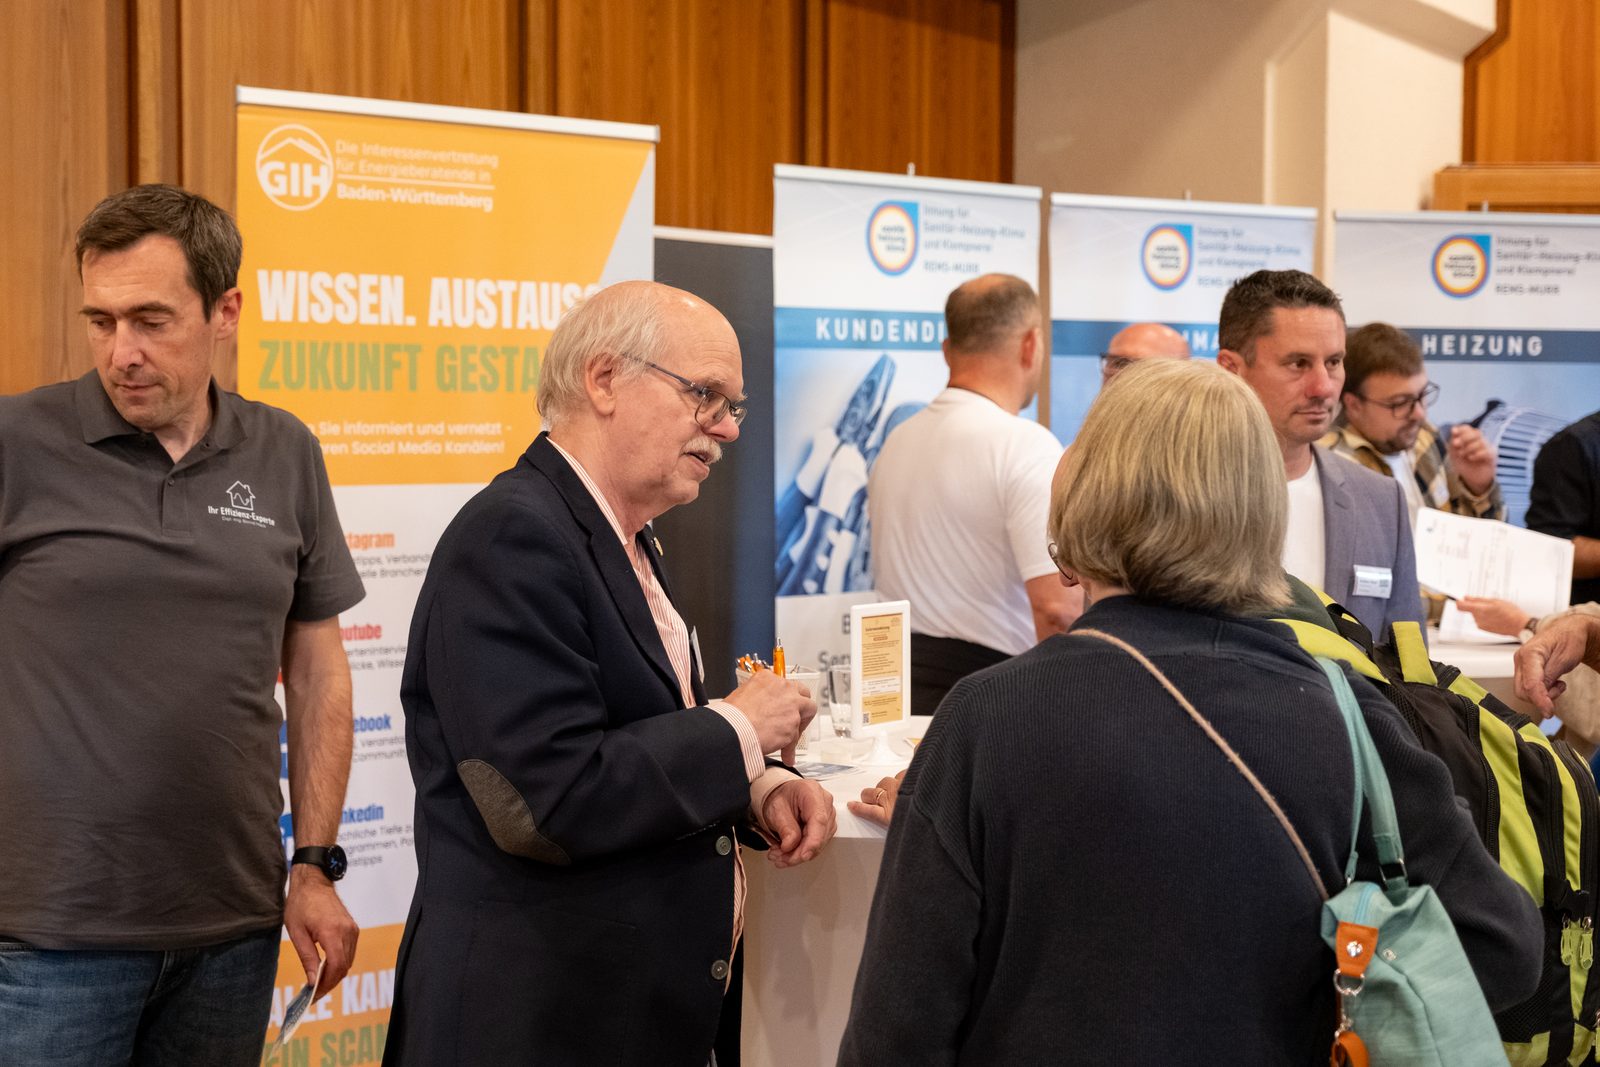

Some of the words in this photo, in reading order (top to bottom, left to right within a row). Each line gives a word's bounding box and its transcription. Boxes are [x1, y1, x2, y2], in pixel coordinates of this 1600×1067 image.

[335, 139, 359, 154] Die
[362, 143, 499, 170] Interessenvertretung
[260, 160, 332, 198] GIH
[335, 157, 355, 172] für
[359, 160, 477, 182] Energieberatende
[336, 183, 494, 213] Baden-Württemberg
[257, 269, 416, 326] WISSEN.
[428, 277, 601, 331] AUSTAUS
[815, 316, 944, 343] KUNDENDI
[1421, 334, 1543, 357] HEIZUNG
[258, 340, 423, 392] ZUKUNFT
[435, 344, 541, 394] GESTA
[319, 421, 341, 435] Sie
[343, 421, 413, 436] informiert
[416, 421, 445, 435] und
[448, 421, 502, 435] vernetzt
[351, 440, 395, 455] Social
[398, 440, 442, 455] Media
[207, 505, 219, 515] Ihr
[220, 506, 276, 527] Effizienz-Experte
[347, 532, 395, 551] tagram
[353, 712, 392, 733] ebook
[342, 802, 384, 824] nkedin
[342, 967, 396, 1016] KAN
